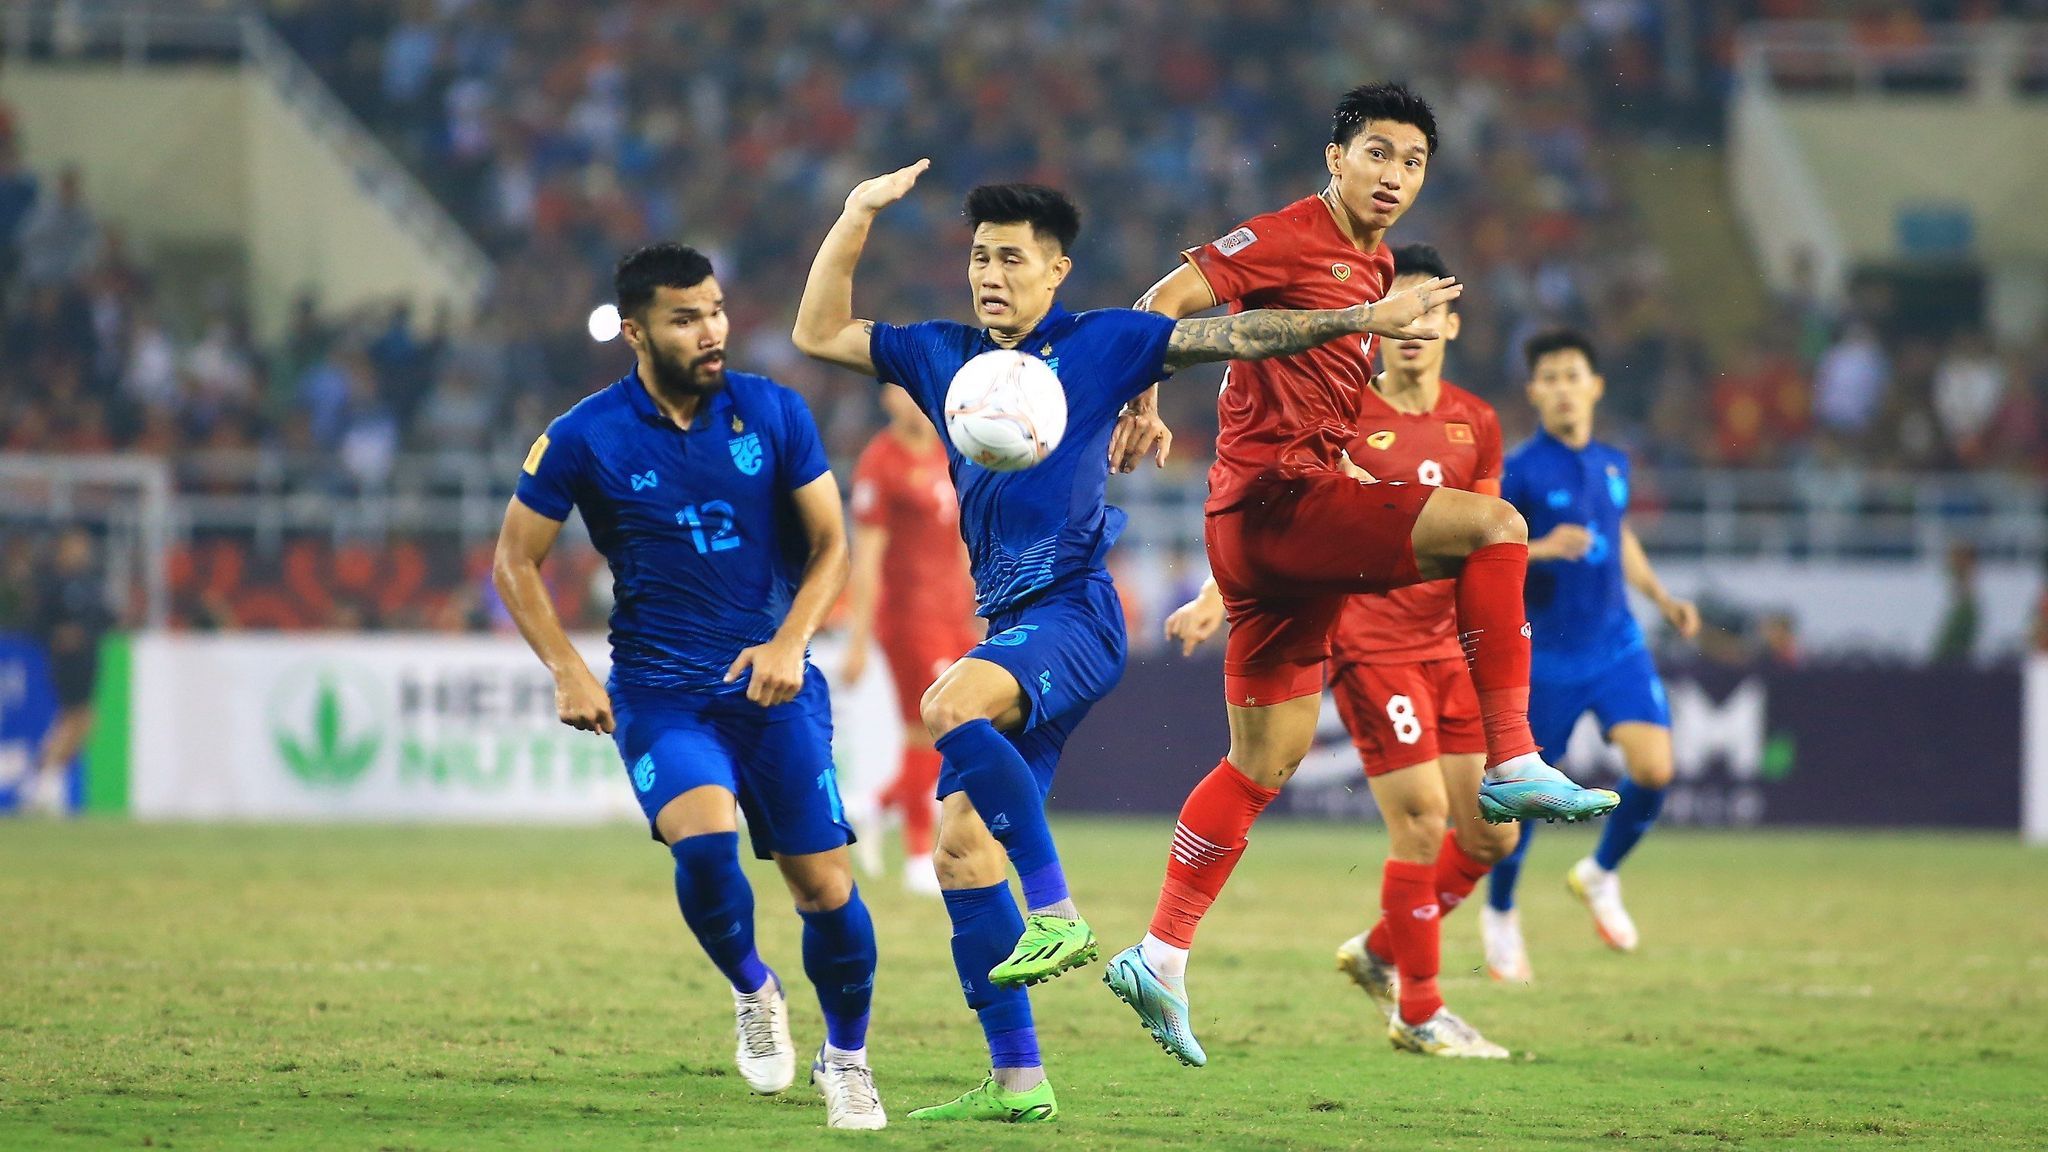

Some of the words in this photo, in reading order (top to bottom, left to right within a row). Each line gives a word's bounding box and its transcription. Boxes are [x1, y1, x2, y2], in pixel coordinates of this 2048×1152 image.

[675, 499, 740, 554] 12
[1386, 694, 1422, 744] 8
[816, 767, 843, 824] 1
